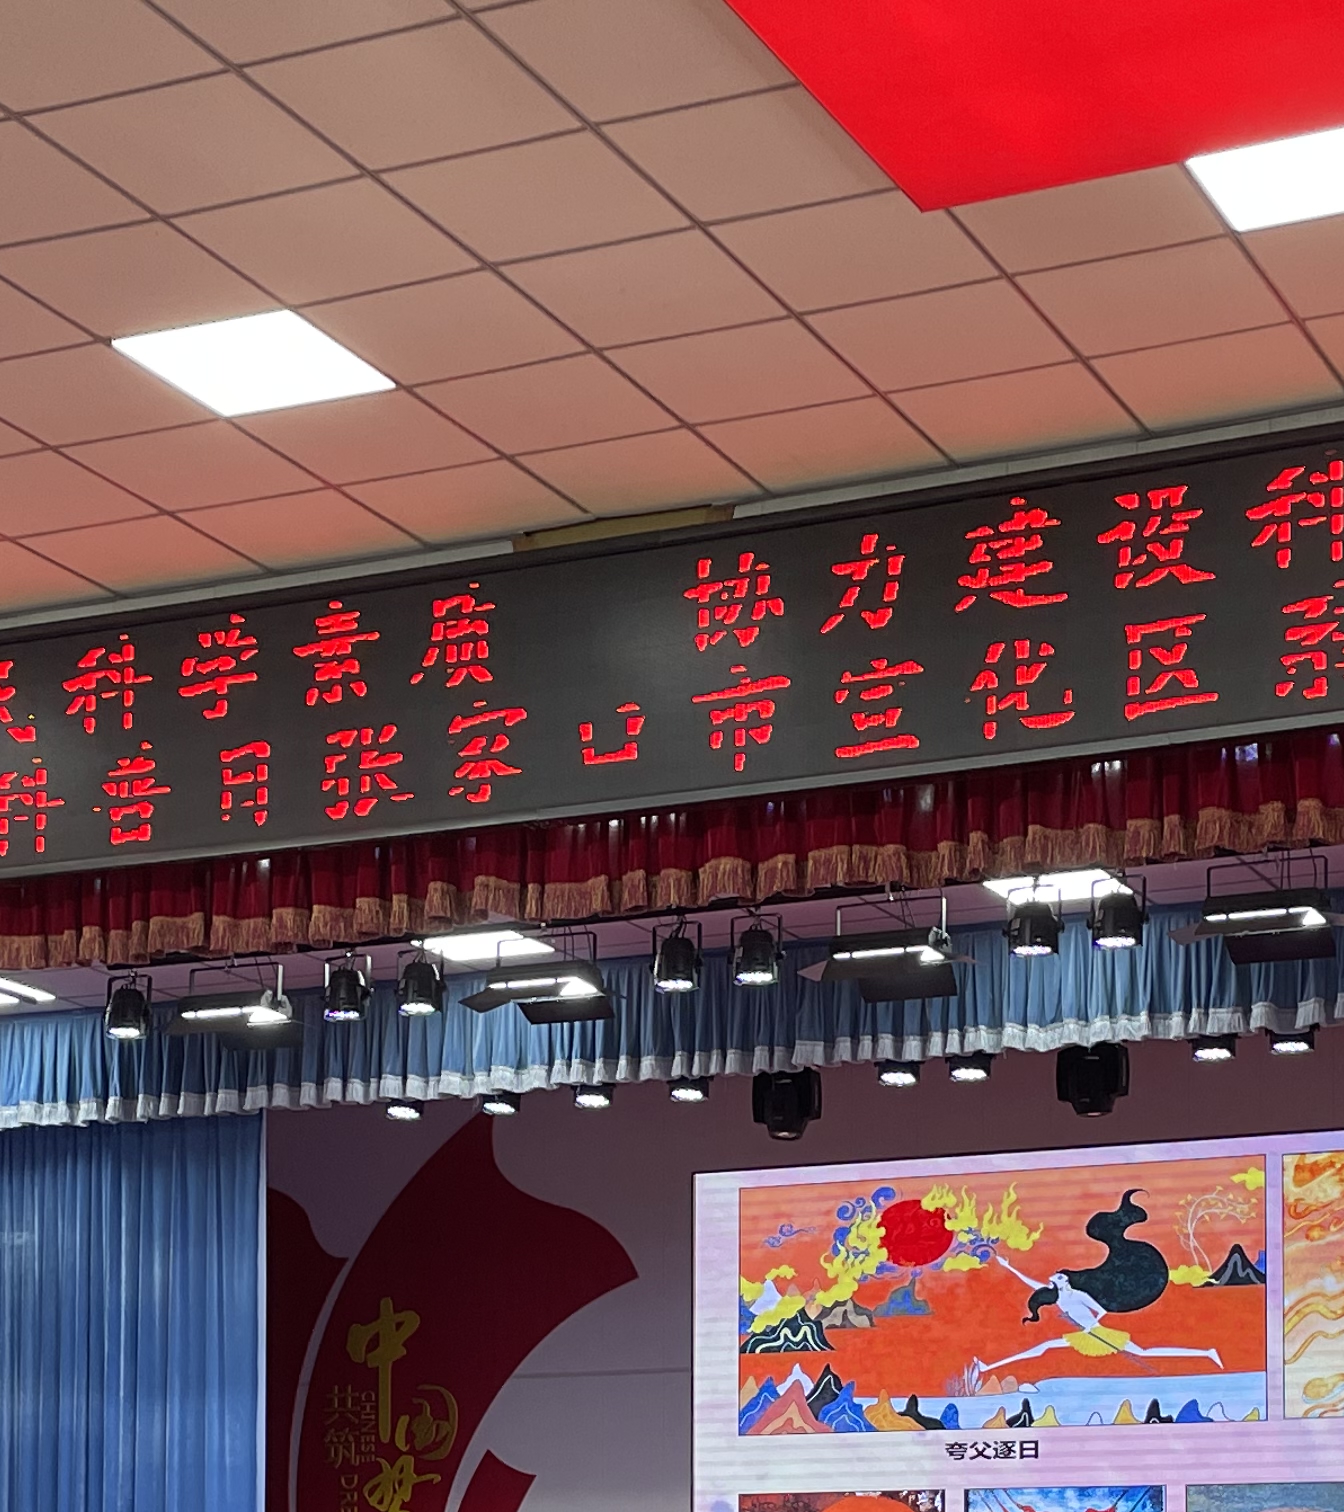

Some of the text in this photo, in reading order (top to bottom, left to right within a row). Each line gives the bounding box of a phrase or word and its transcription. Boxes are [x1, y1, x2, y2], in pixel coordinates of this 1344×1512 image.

[361, 1390, 376, 1463] CHINESE
[944, 1440, 1040, 1461] 夸父逐日
